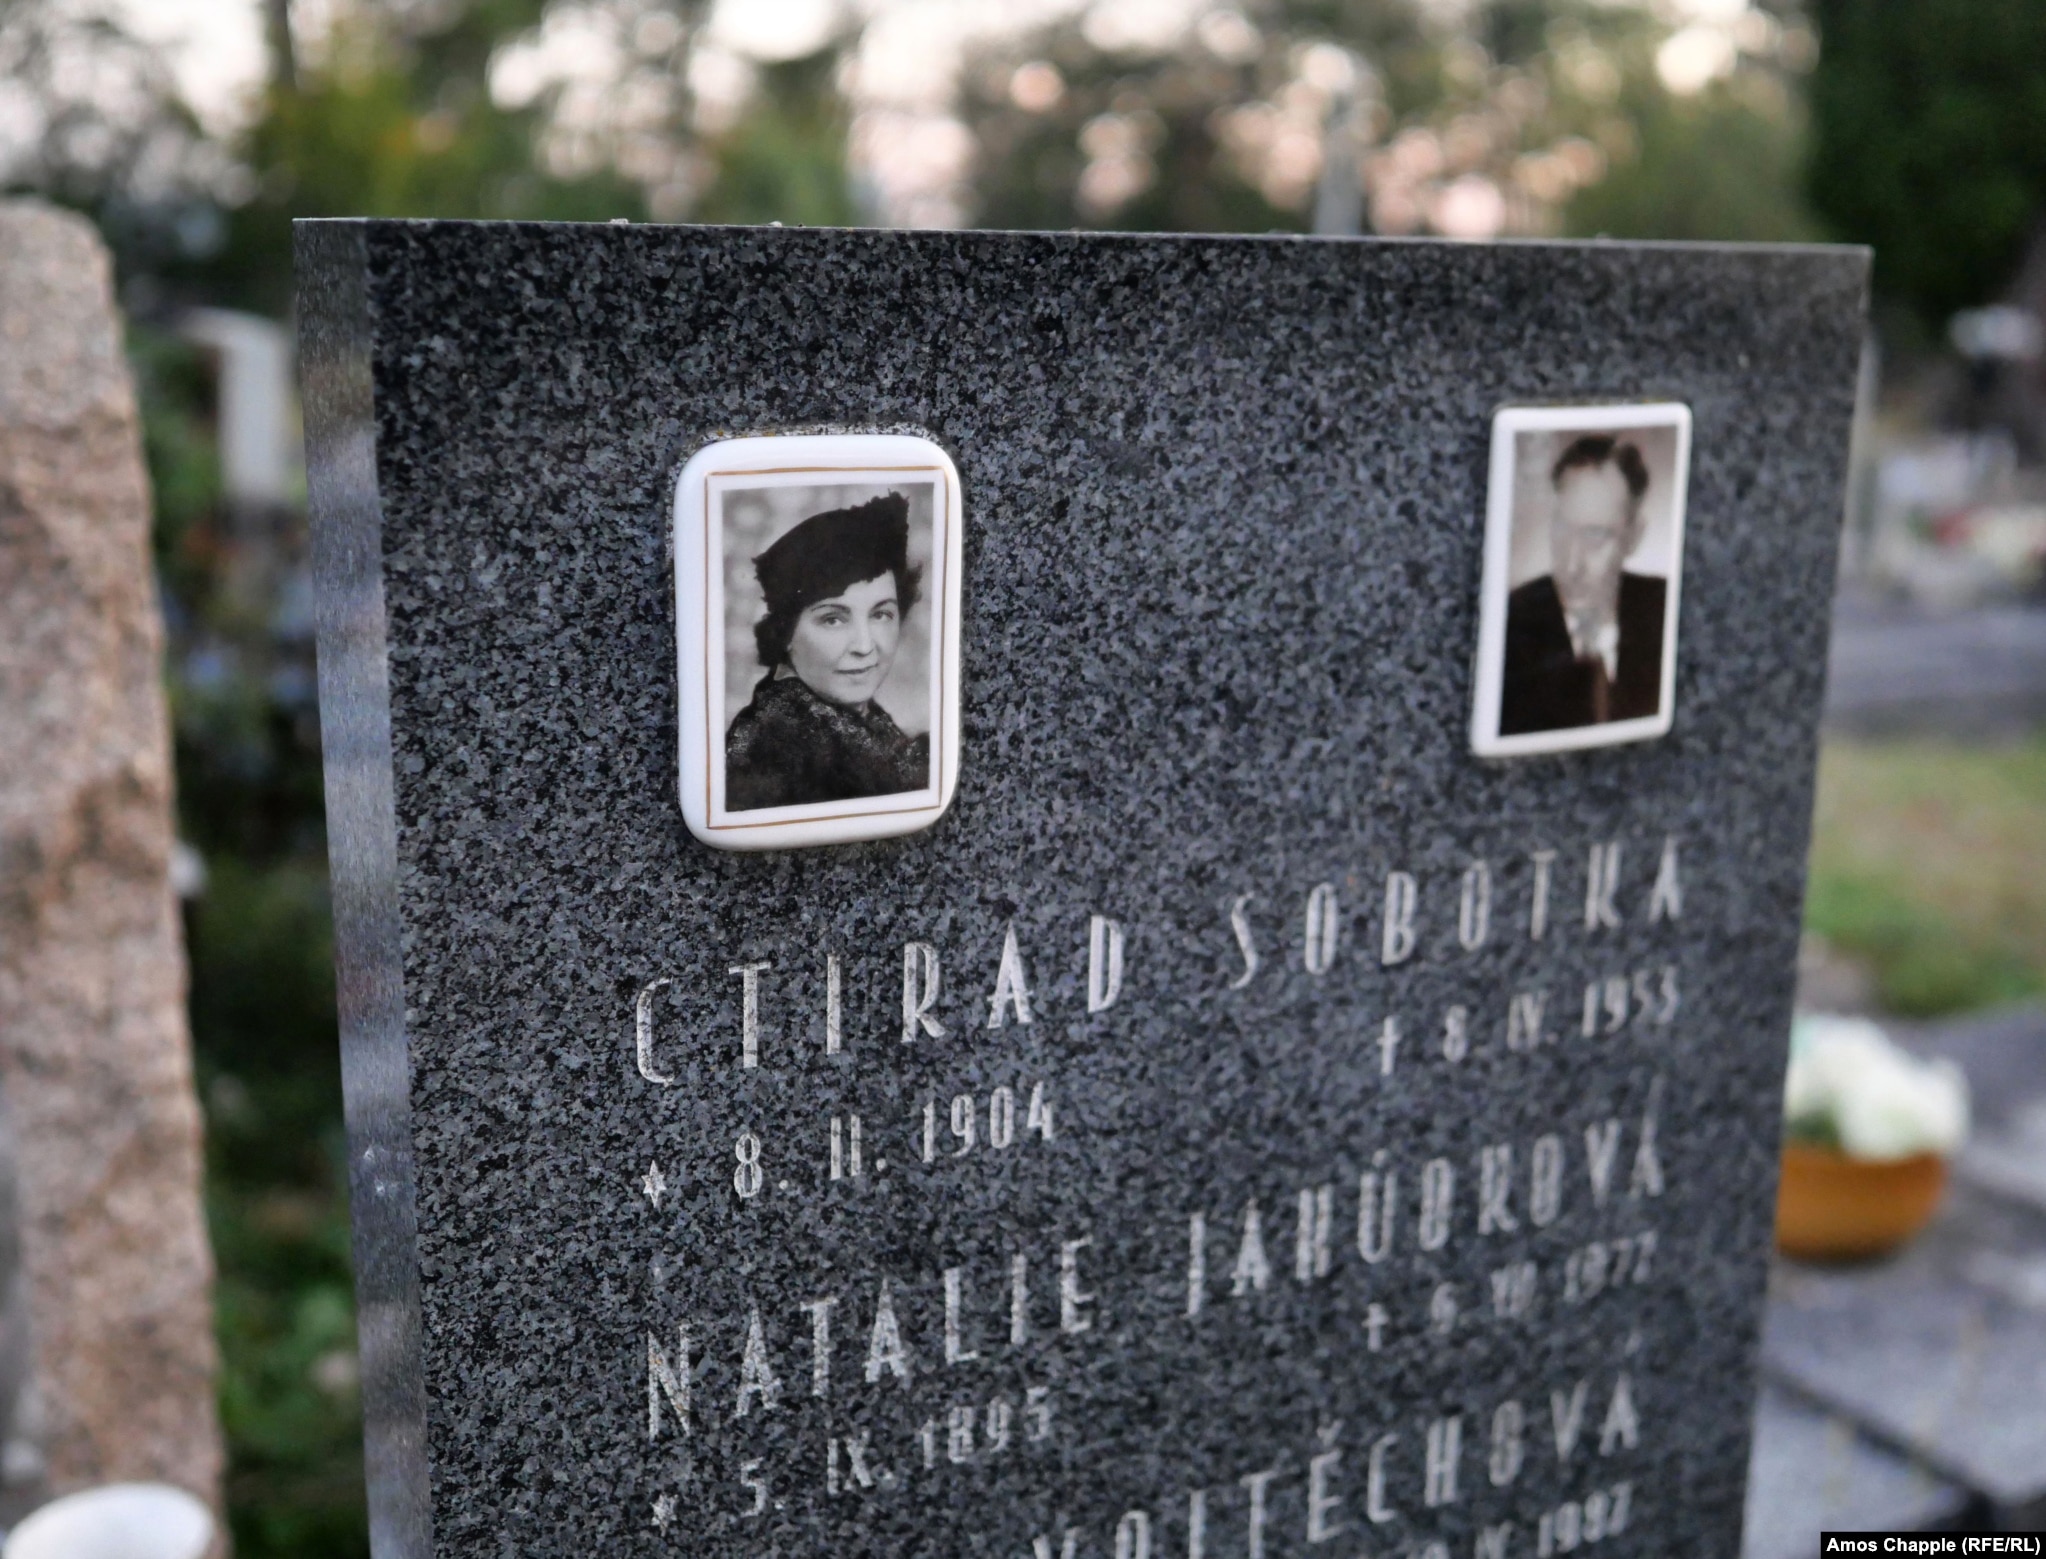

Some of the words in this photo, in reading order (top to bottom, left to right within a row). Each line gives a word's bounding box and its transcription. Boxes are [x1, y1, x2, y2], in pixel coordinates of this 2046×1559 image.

[636, 914, 1125, 1087] CTIRAD
[1230, 836, 1683, 991] SOBOTKA
[733, 1132, 790, 1199] 8.
[922, 1080, 1055, 1164] 1904
[647, 1234, 1096, 1441] NATALIE
[920, 1385, 1052, 1471] 1895
